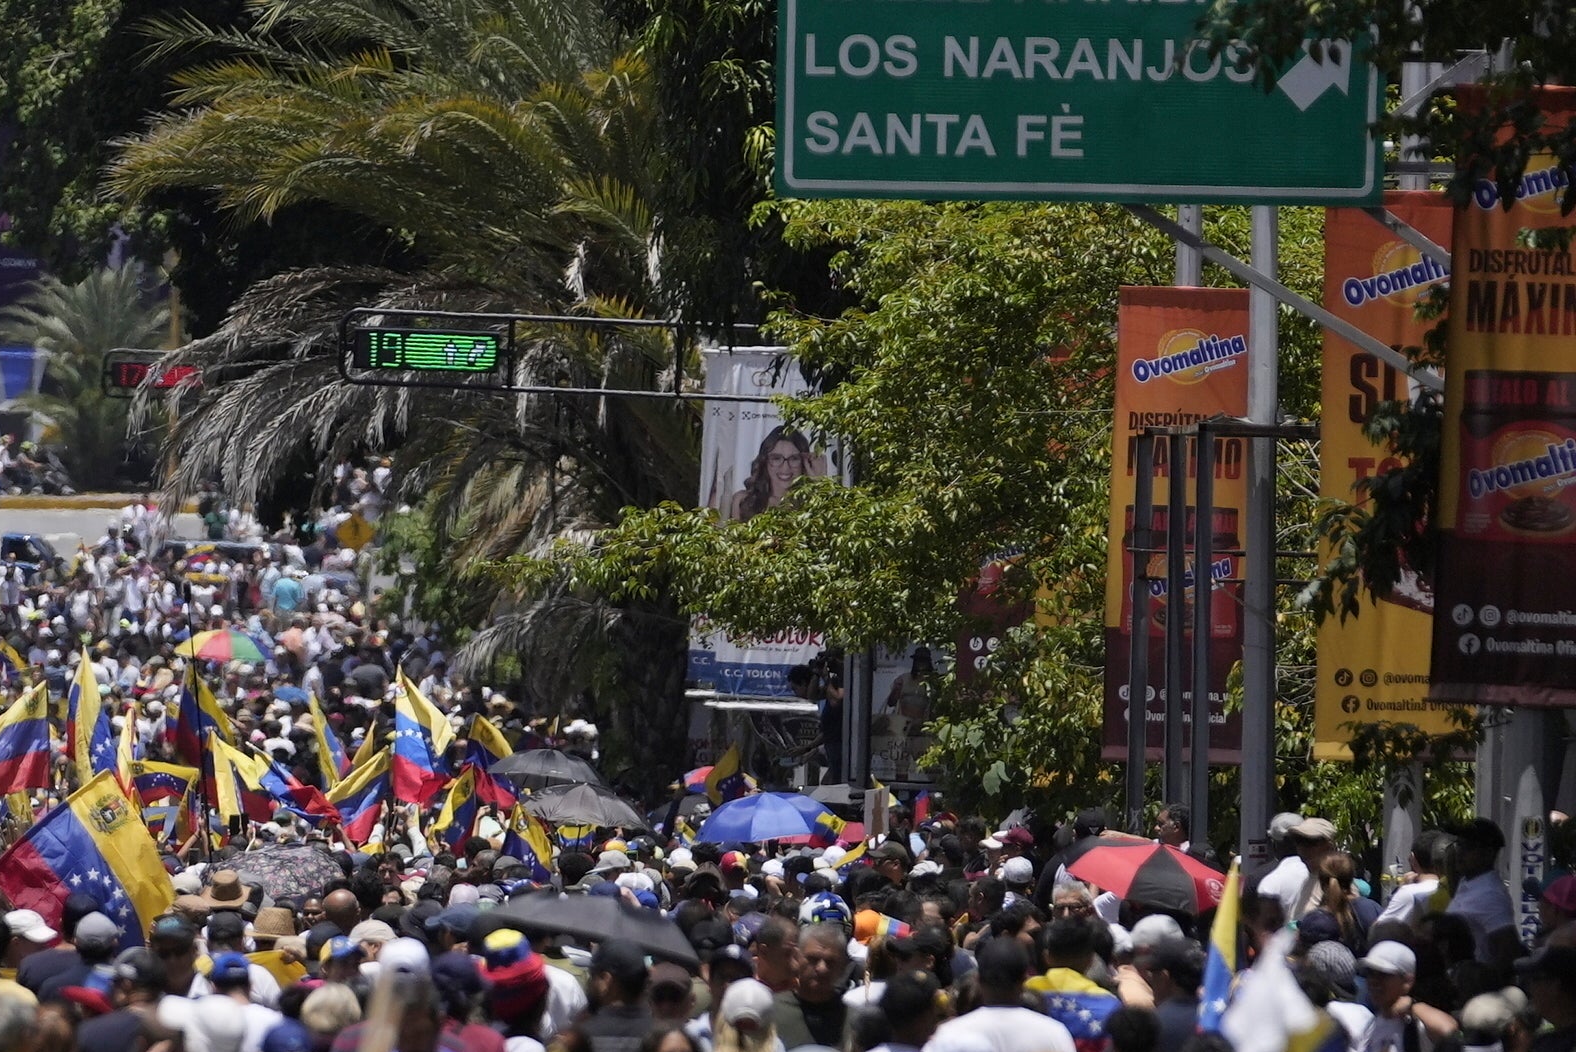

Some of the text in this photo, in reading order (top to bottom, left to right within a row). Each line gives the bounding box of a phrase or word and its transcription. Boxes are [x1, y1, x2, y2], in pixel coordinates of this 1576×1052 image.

[804, 33, 1256, 83] LOS NARANJOS
[804, 110, 997, 157] SANTA
[369, 333, 403, 367] 19
[1132, 333, 1247, 384] Ovomaltina
